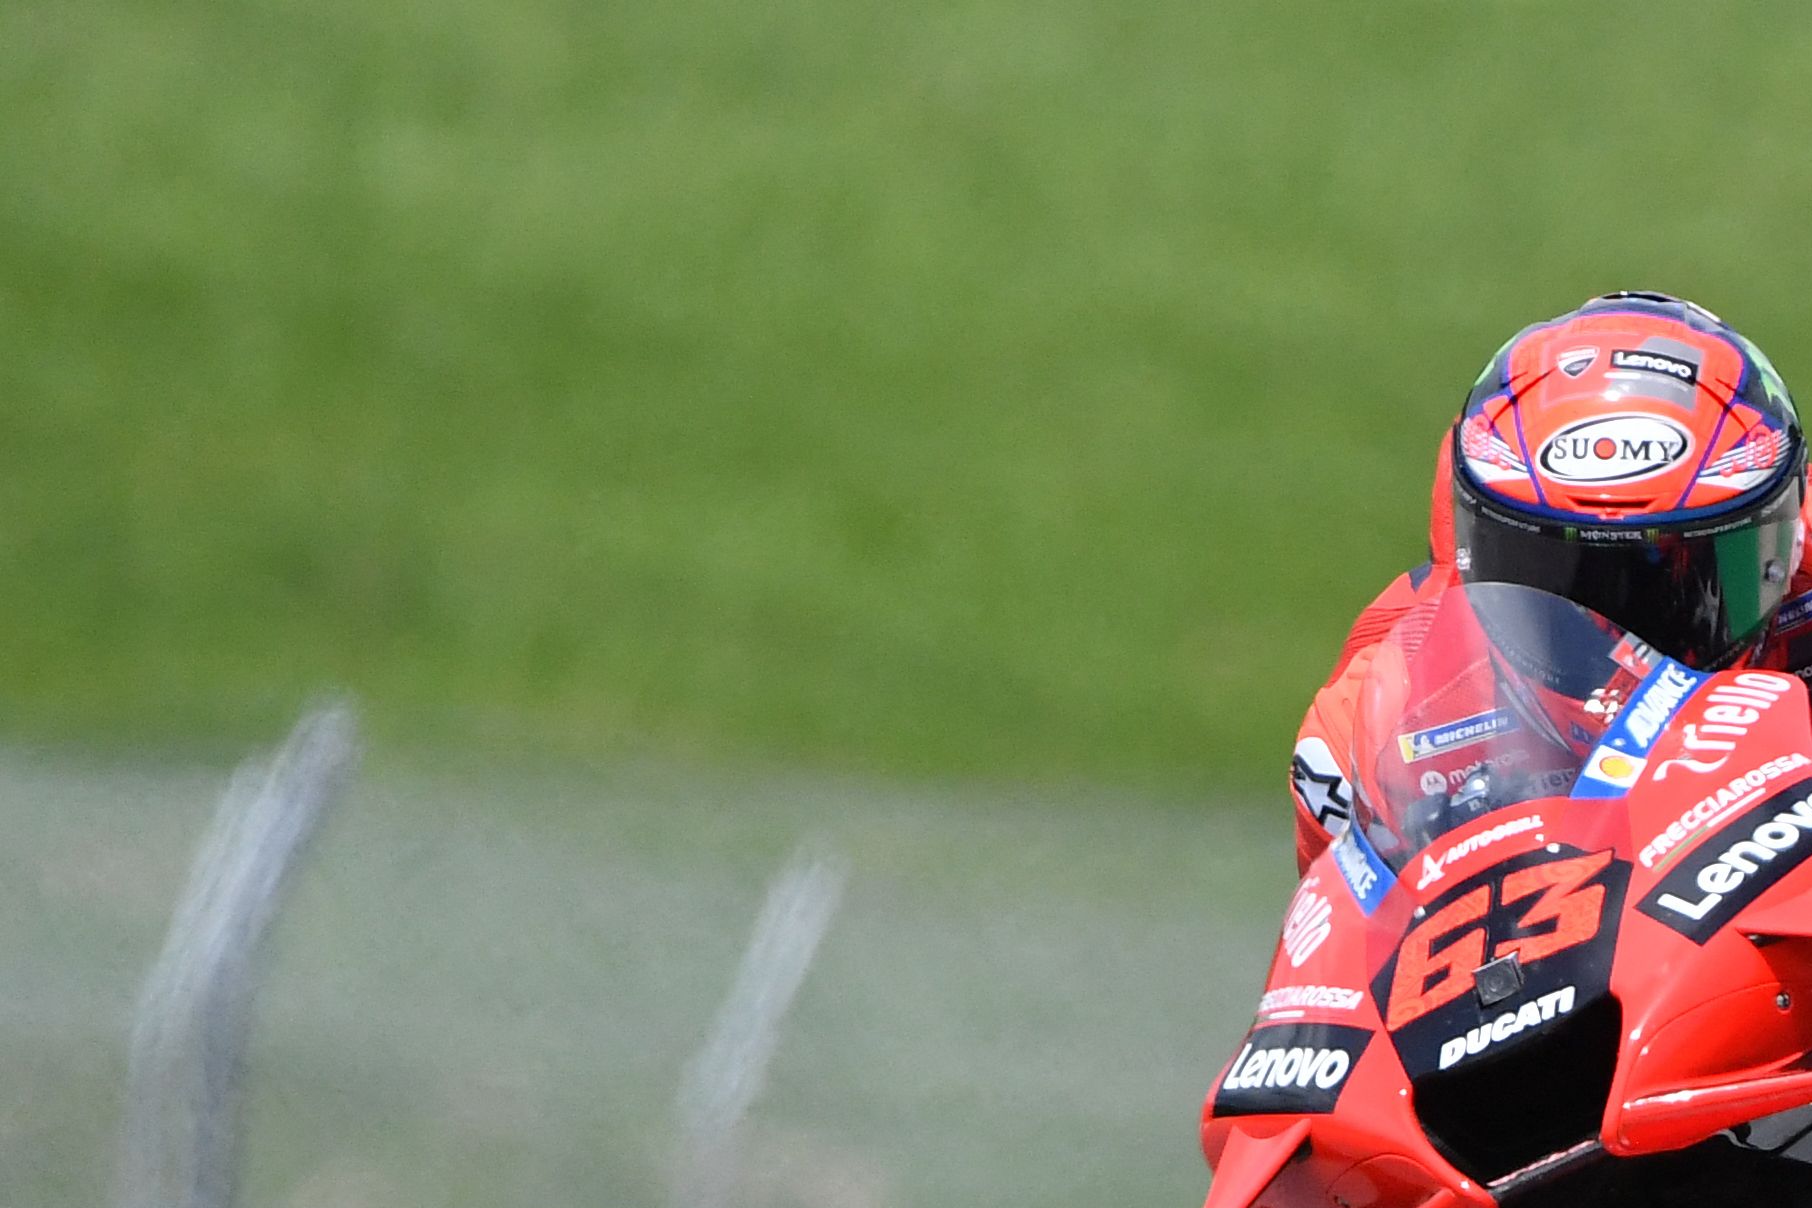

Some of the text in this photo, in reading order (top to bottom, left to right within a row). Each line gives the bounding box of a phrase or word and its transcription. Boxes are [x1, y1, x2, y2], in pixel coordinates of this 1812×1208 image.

[1616, 351, 1692, 378] Lenovo
[1553, 436, 1680, 463] SUOMY
[1579, 528, 1643, 542] MONSTER
[1626, 663, 1698, 748] ADVANCE
[1433, 716, 1509, 746] MICHELIN
[1638, 752, 1812, 868] FRECCIAROSSA
[1385, 849, 1614, 1032] 63
[1438, 985, 1577, 1071] DUCATI
[1222, 1042, 1350, 1090] Lenovo
